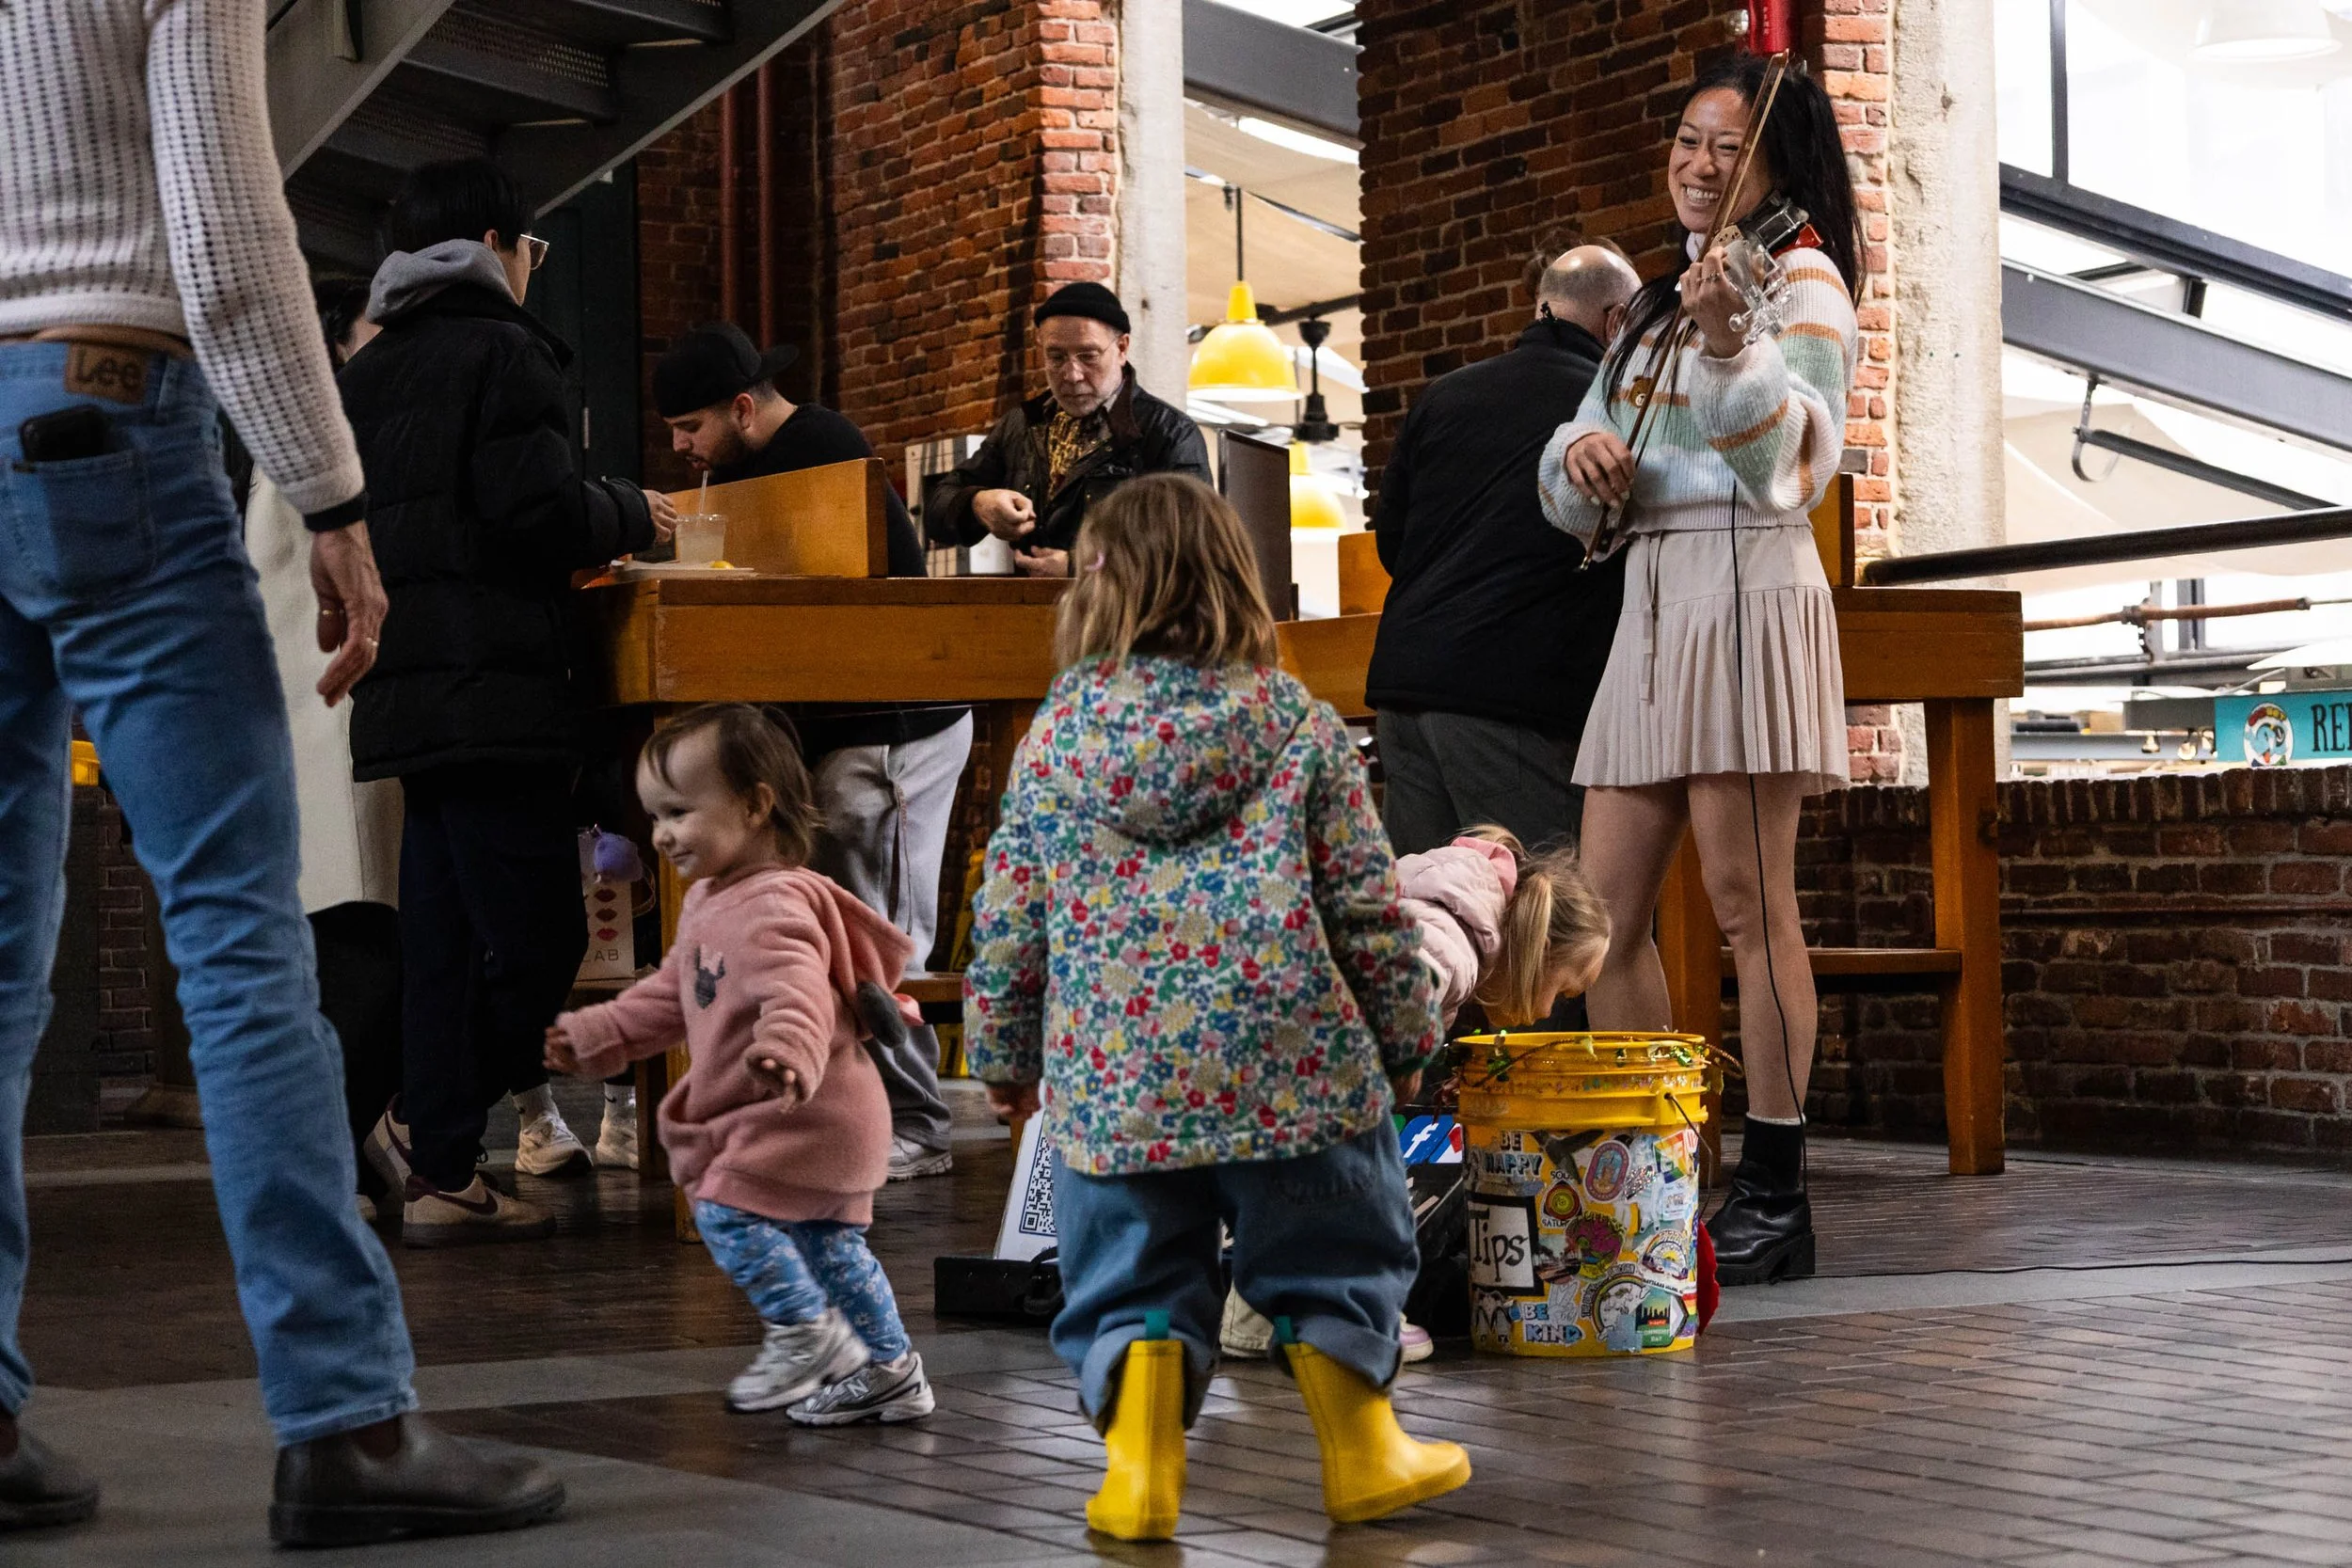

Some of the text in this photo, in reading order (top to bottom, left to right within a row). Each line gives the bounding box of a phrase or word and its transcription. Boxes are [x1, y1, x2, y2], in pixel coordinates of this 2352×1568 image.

[75, 345, 143, 391] Lee
[1485, 1153, 1543, 1176] HAPPY
[1470, 1206, 1530, 1283] Tips
[1523, 1303, 1549, 1323] BE
[1525, 1323, 1584, 1345] KIND
